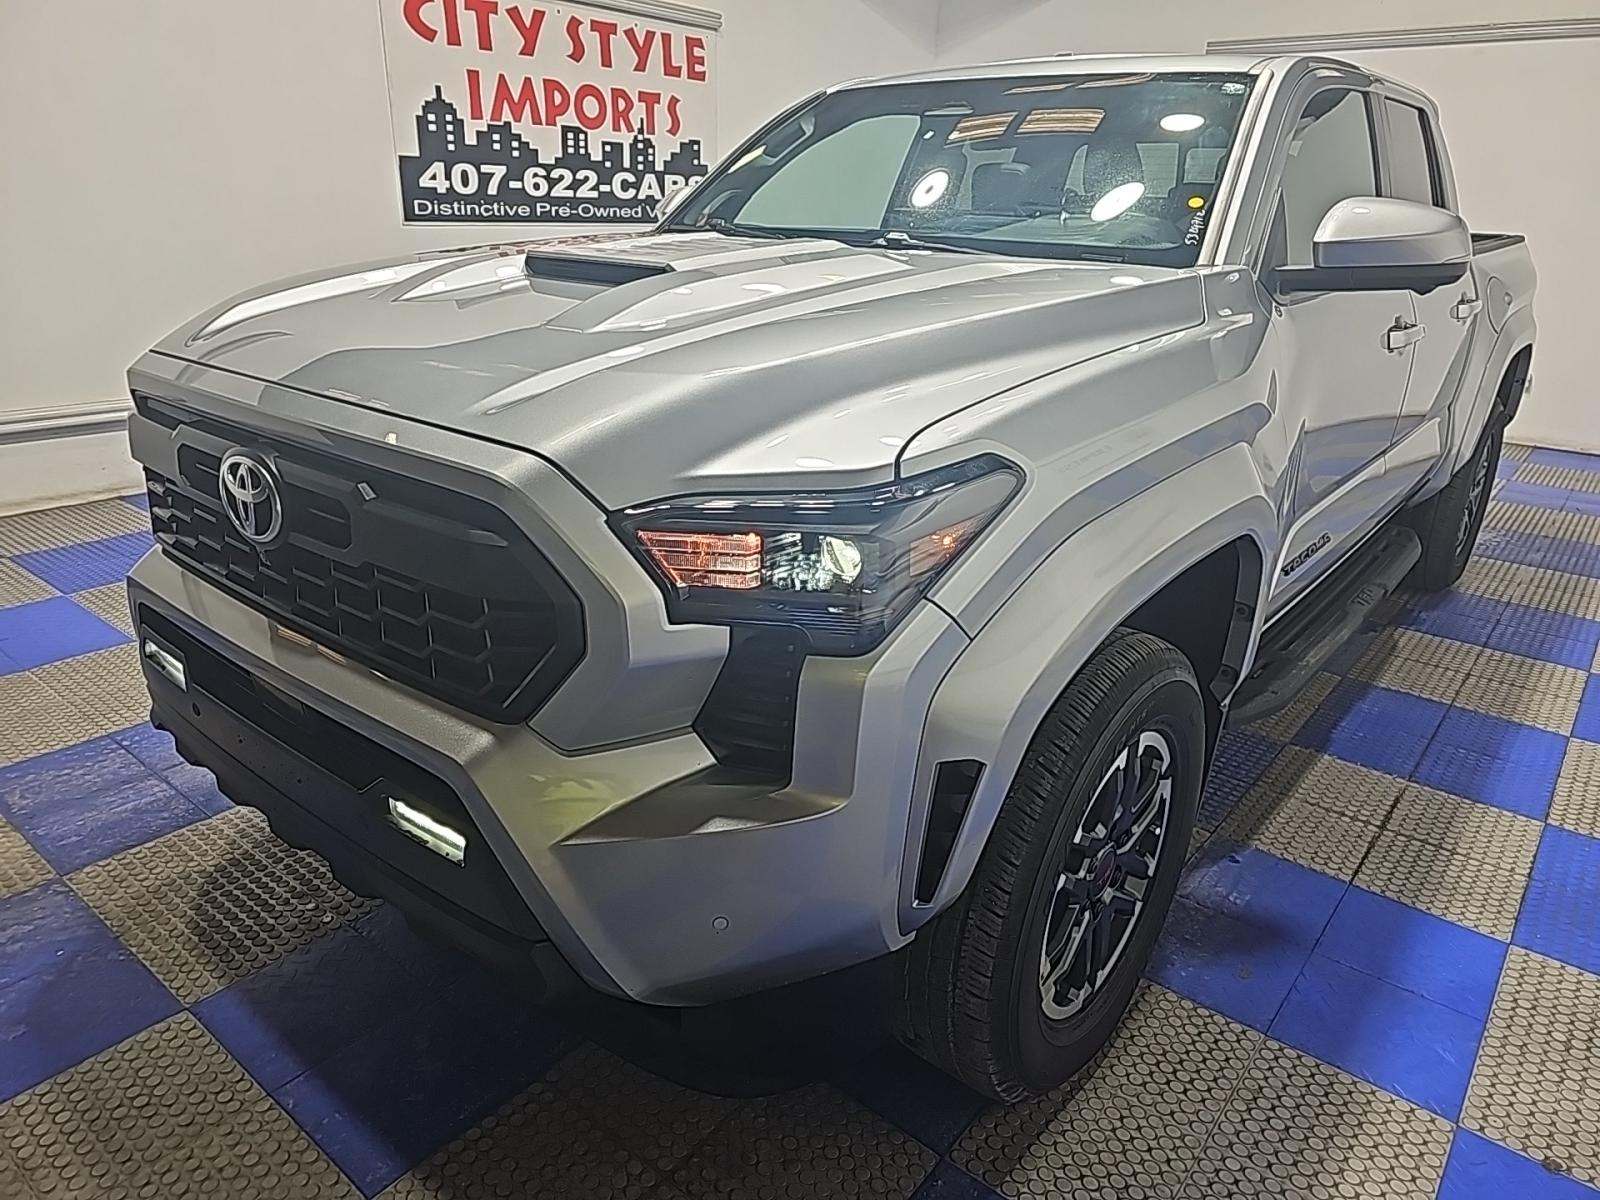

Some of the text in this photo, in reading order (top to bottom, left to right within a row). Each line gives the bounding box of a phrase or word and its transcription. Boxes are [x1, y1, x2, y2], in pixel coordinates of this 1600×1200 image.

[403, 0, 707, 82] CITY STYLE
[466, 68, 682, 137] IMPORTS
[413, 199, 531, 218] Distinctive
[535, 201, 643, 219] Pre-Owned
